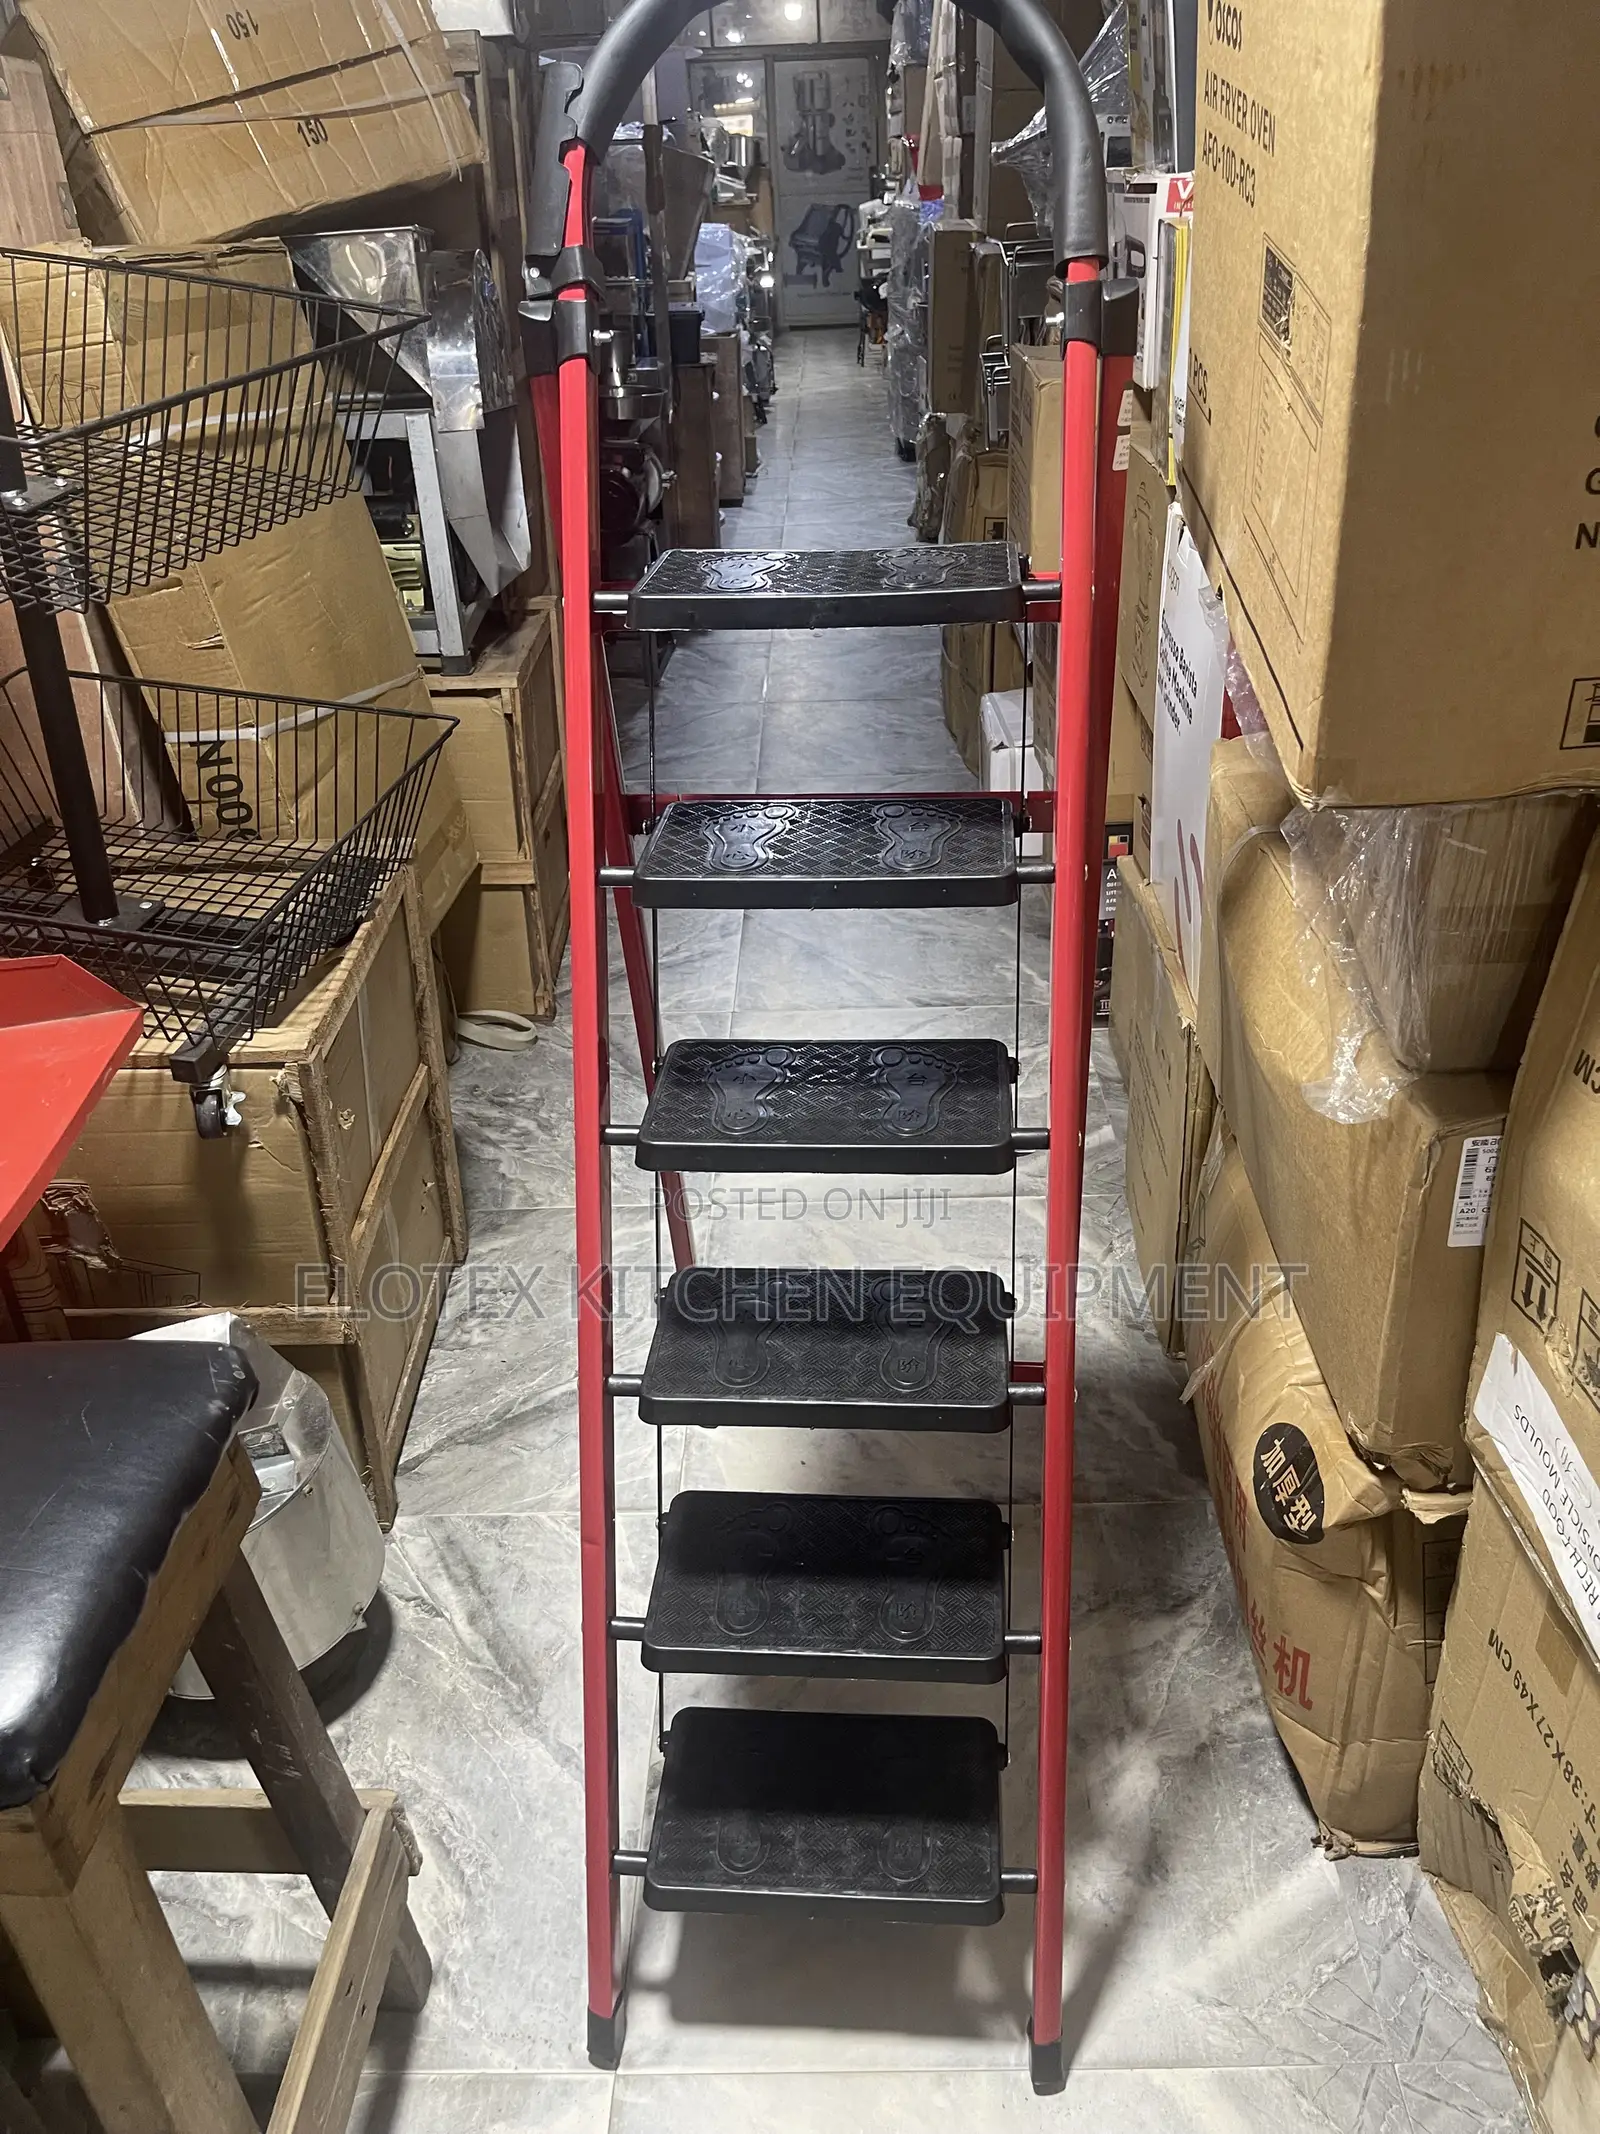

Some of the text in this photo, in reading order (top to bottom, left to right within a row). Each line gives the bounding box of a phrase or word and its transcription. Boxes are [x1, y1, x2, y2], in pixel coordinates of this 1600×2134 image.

[226, 9, 259, 40] 150
[297, 118, 329, 147] 150
[1204, 69, 1276, 157] AIR FRYER OVEN
[1202, 128, 1256, 208] AFO-10D-RC3
[1193, 354, 1208, 404] PCS
[1171, 671, 1193, 725] Machine
[1179, 647, 1198, 699] Barista
[1459, 1207, 1477, 1215] A20
[1260, 1436, 1317, 1538] 加厚型
[1513, 1404, 1600, 1573] OPSICLE MOULDS
[1487, 1627, 1512, 1673] CM
[1513, 1668, 1600, 1851] 寸:38X27X49
